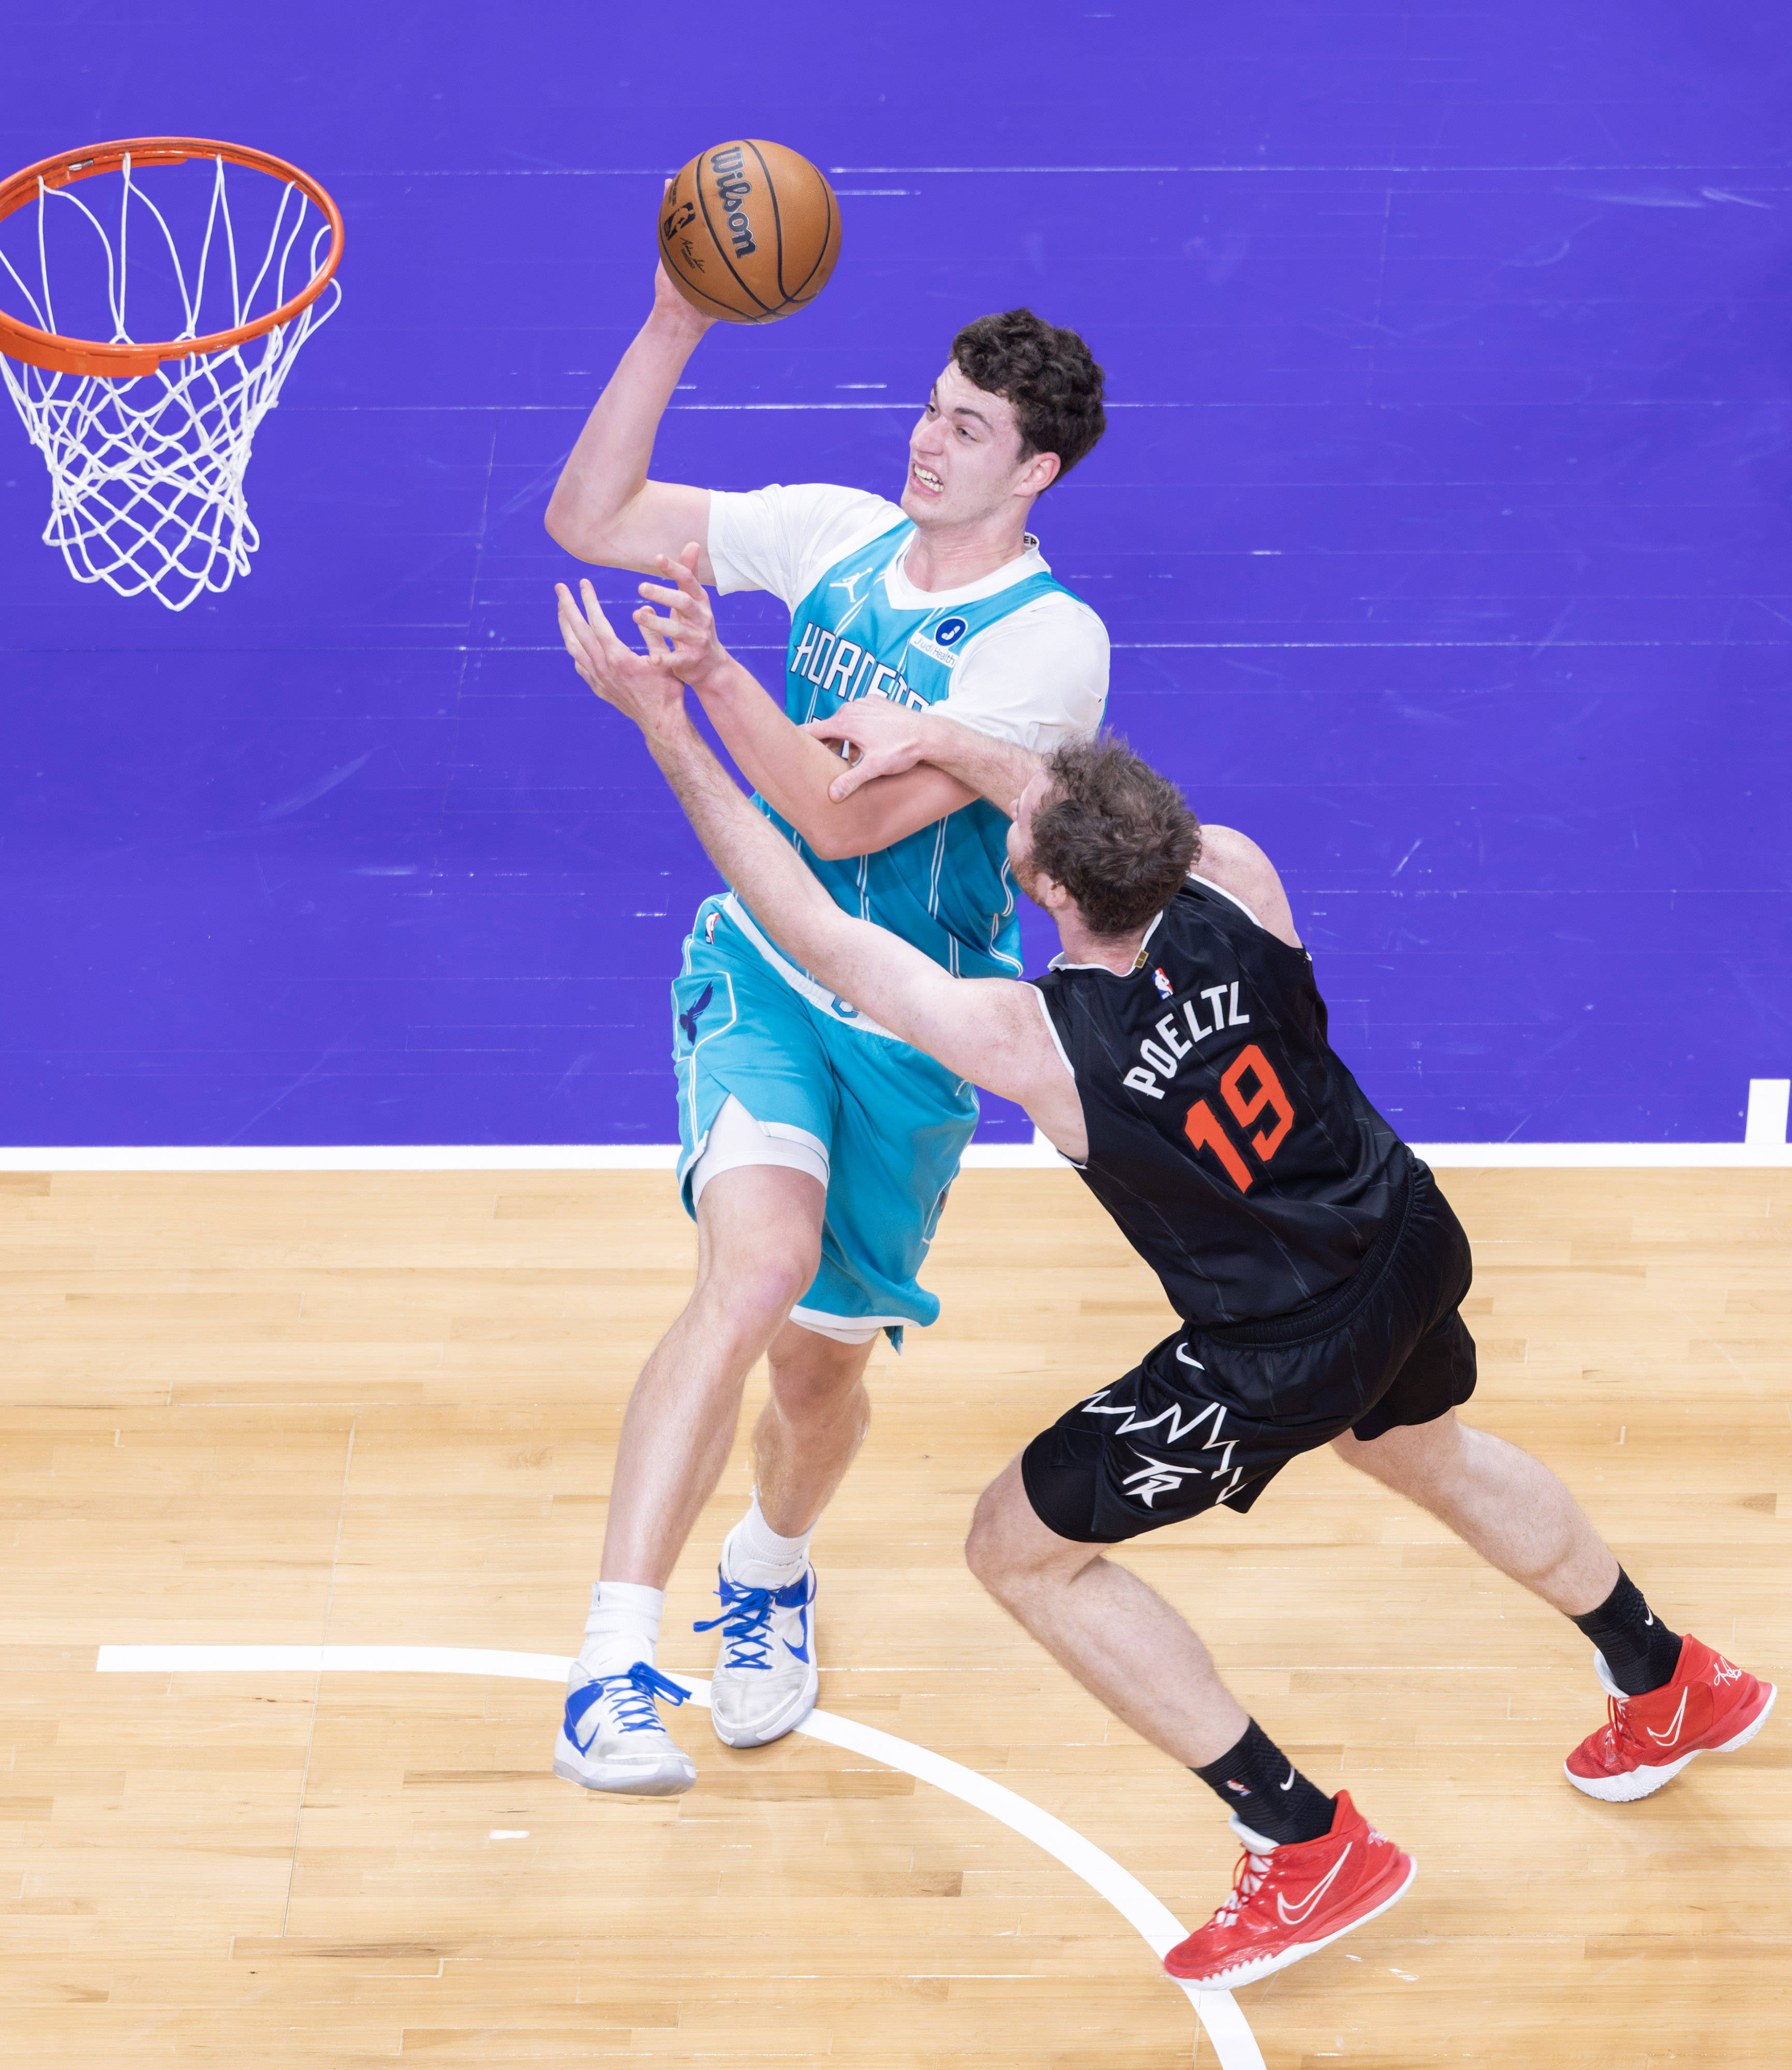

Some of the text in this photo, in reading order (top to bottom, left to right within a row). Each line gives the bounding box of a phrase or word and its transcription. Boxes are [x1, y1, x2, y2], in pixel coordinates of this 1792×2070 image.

[710, 146, 757, 259] Wilson
[933, 647, 955, 665] Health
[1122, 981, 1250, 1100] POELTL
[1184, 1044, 1294, 1194] 19
